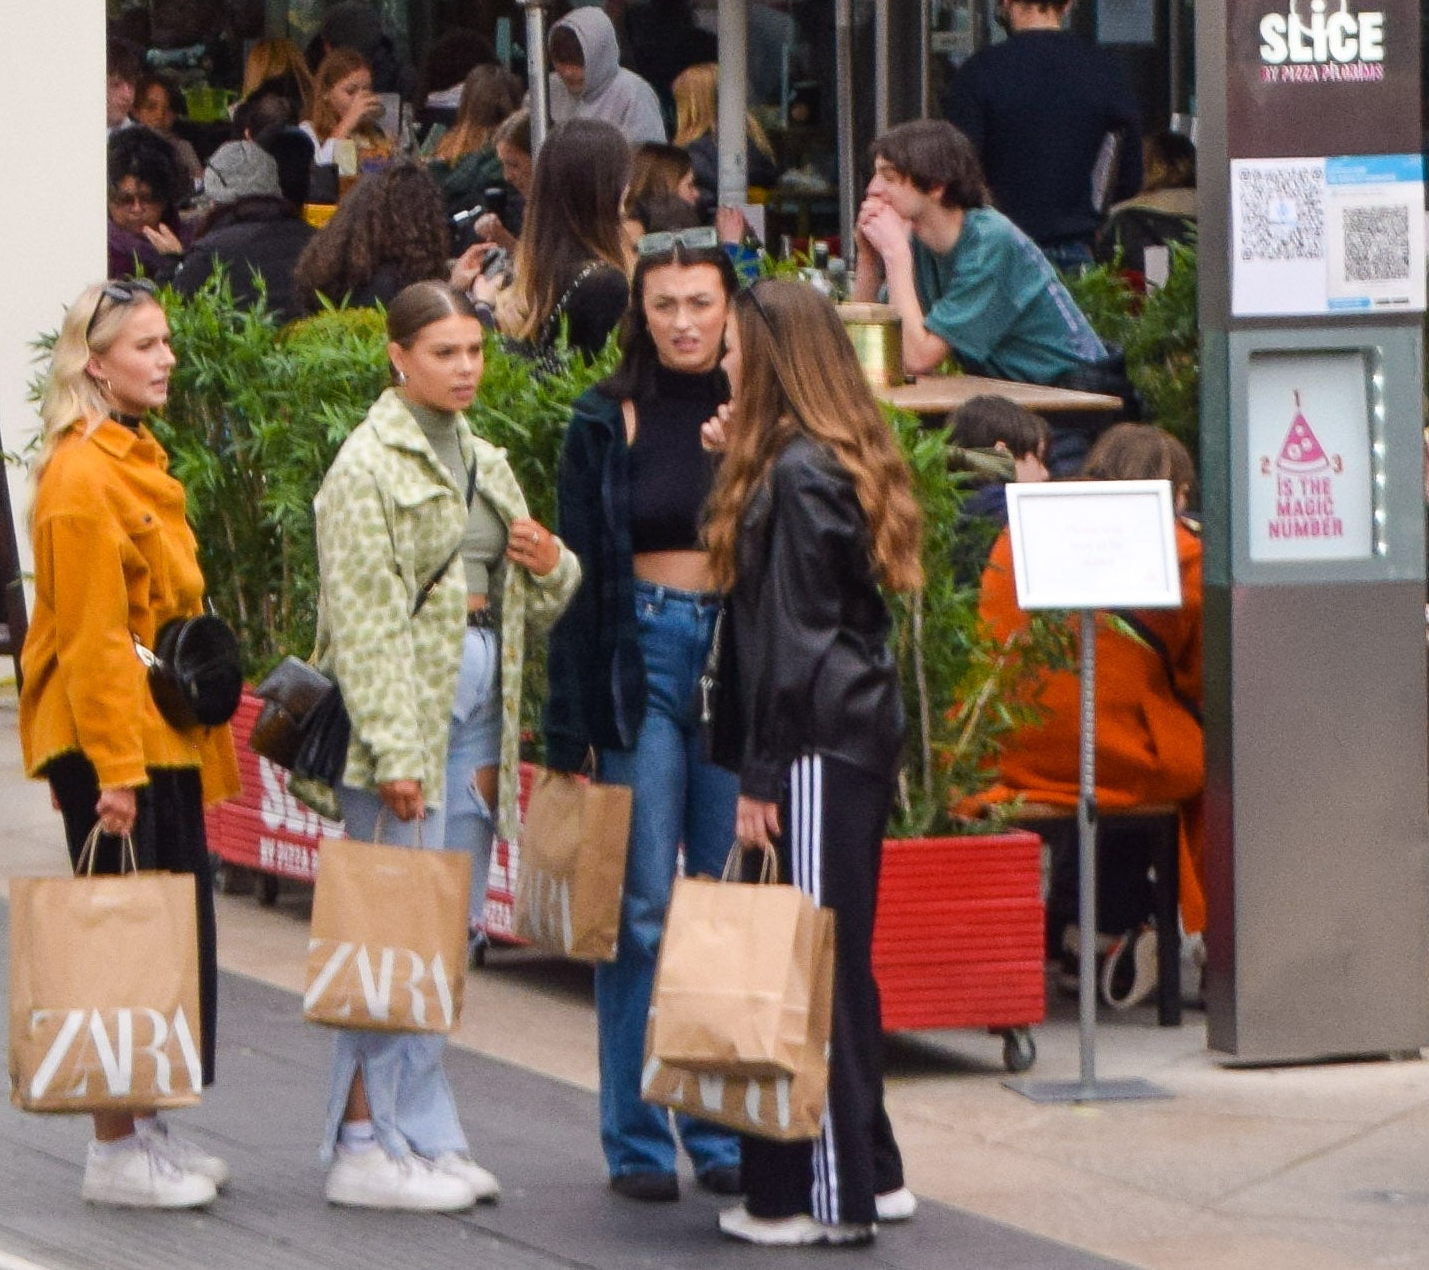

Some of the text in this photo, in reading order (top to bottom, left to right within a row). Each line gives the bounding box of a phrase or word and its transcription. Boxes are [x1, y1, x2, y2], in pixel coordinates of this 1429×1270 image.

[1268, 518, 1344, 538] NUMBER
[302, 937, 454, 1028] ZARA
[29, 1004, 203, 1100] ZARA
